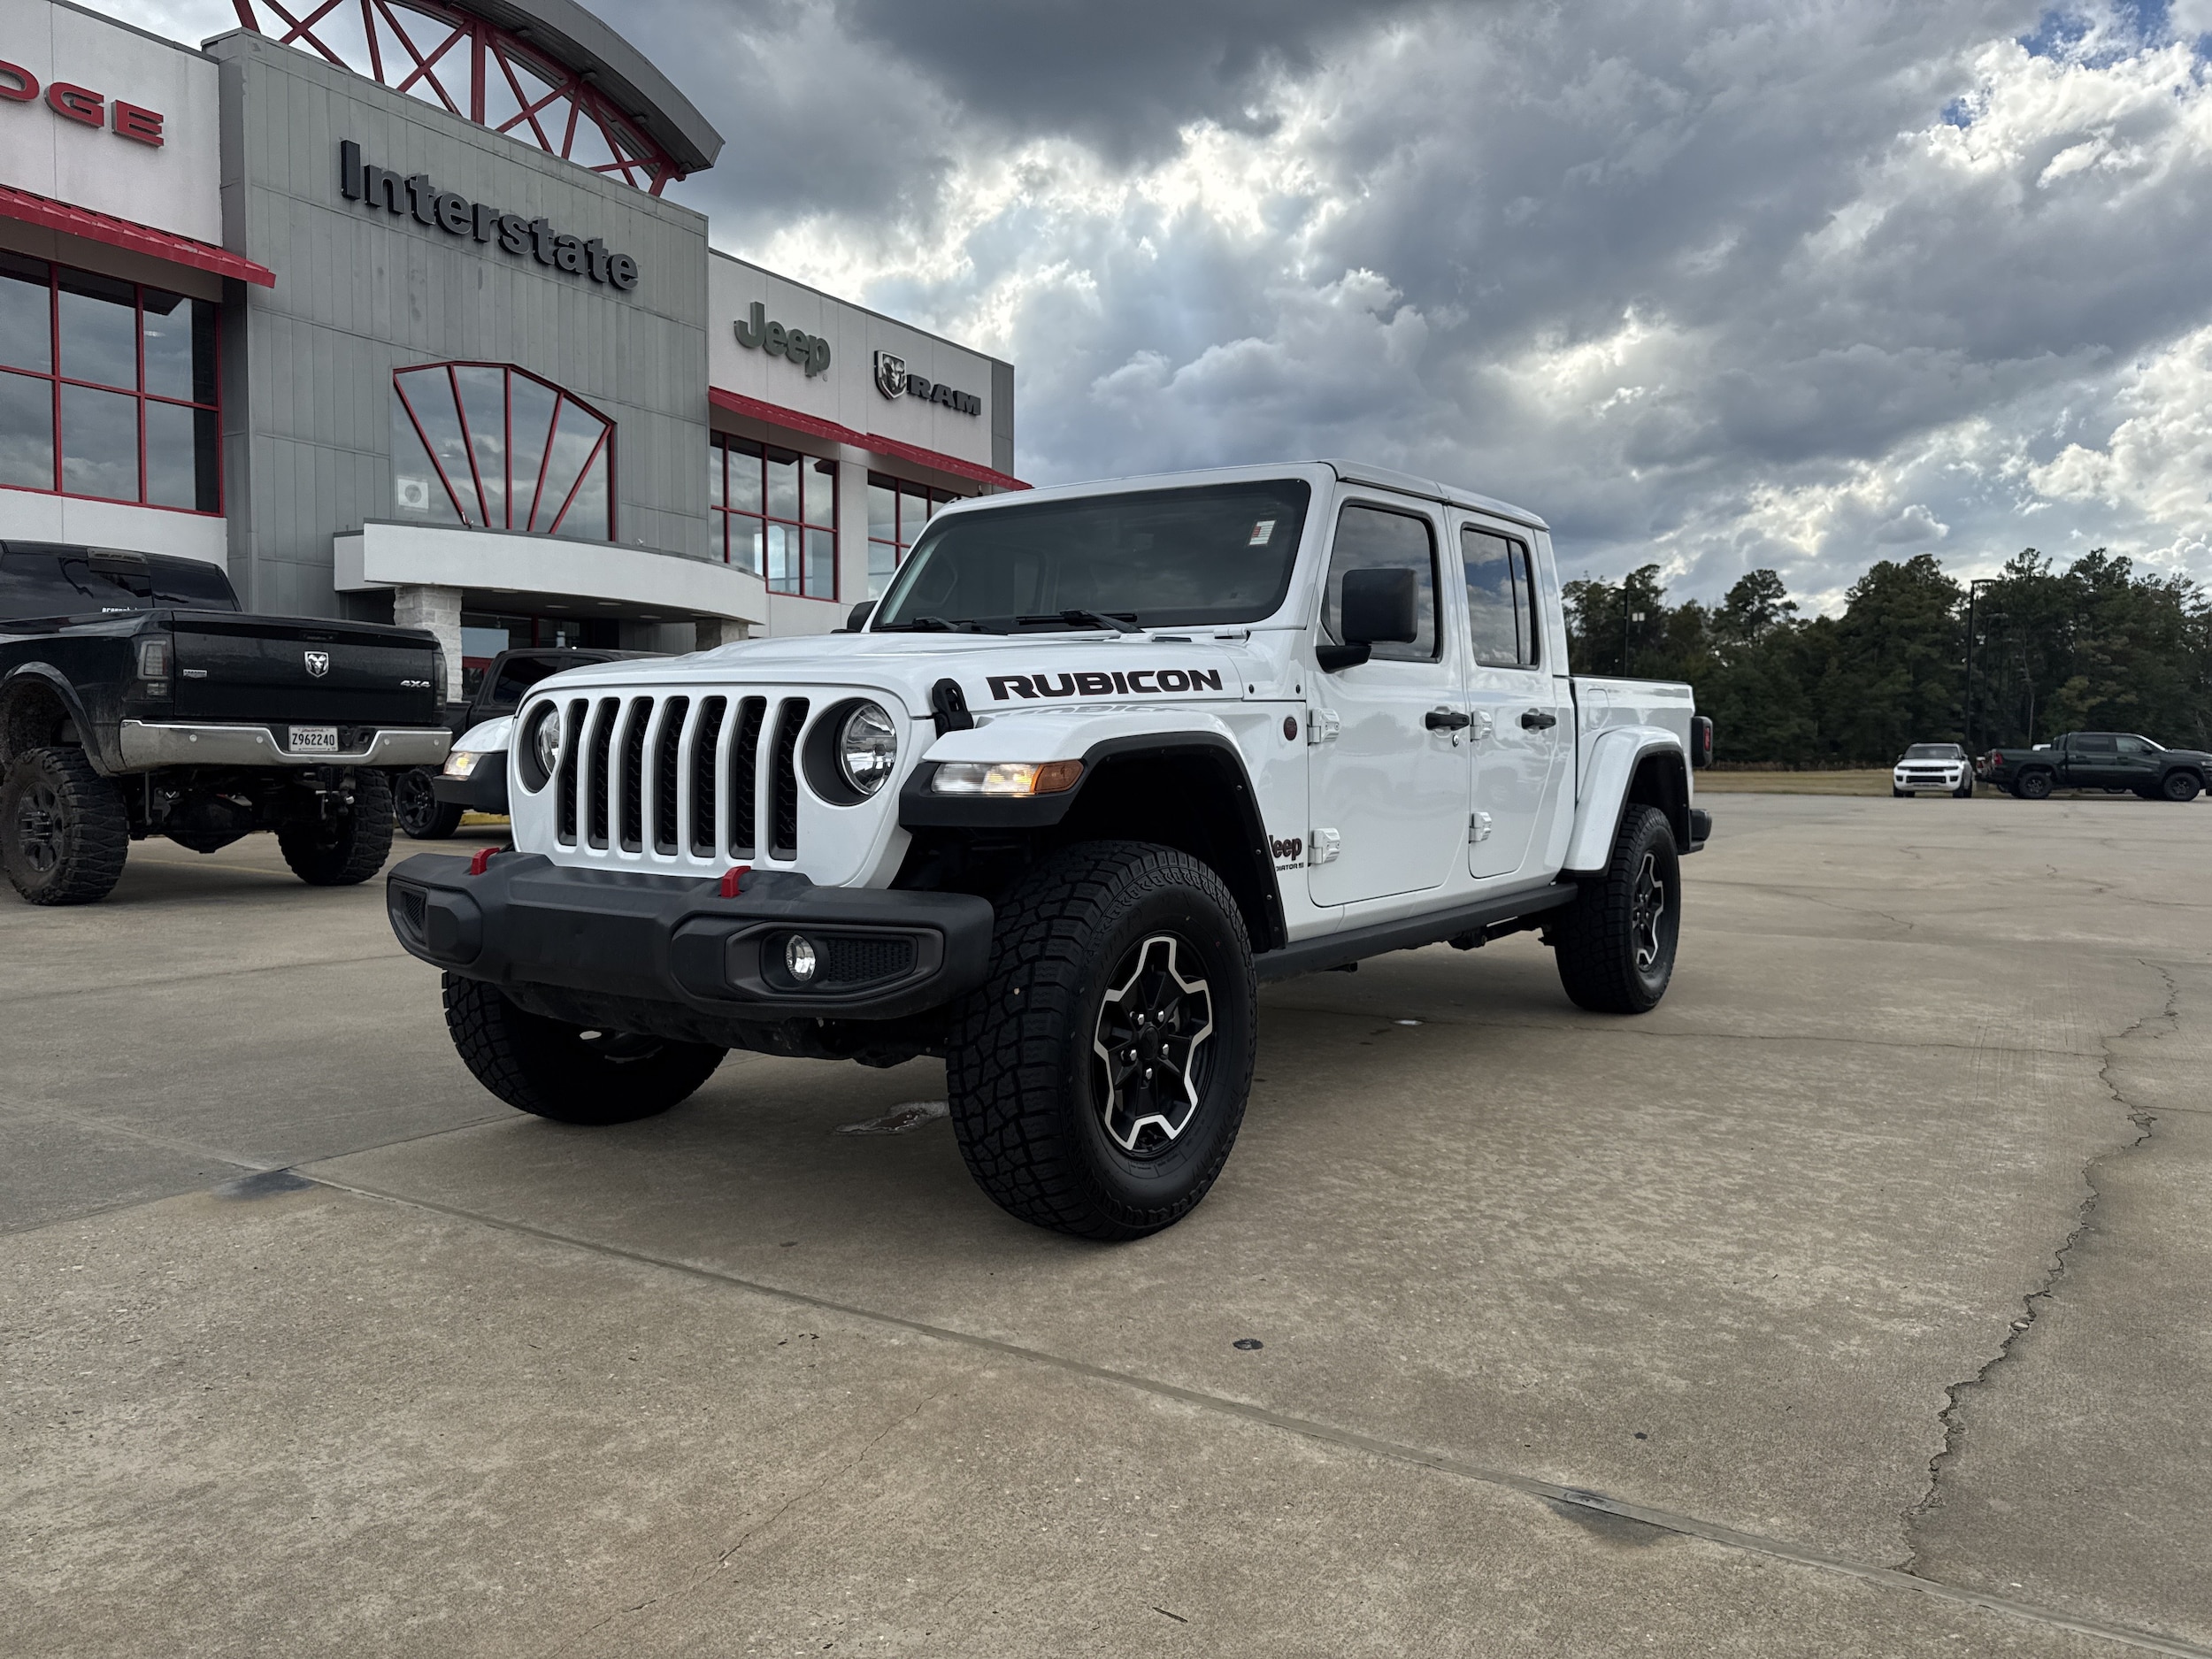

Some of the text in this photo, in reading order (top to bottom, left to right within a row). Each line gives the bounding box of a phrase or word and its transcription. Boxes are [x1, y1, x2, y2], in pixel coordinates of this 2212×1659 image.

[341, 139, 640, 290] Interstate
[733, 301, 831, 377] Jeep
[906, 373, 981, 416] RAM
[986, 669, 1223, 701] RUBICON
[292, 733, 335, 746] Z962240
